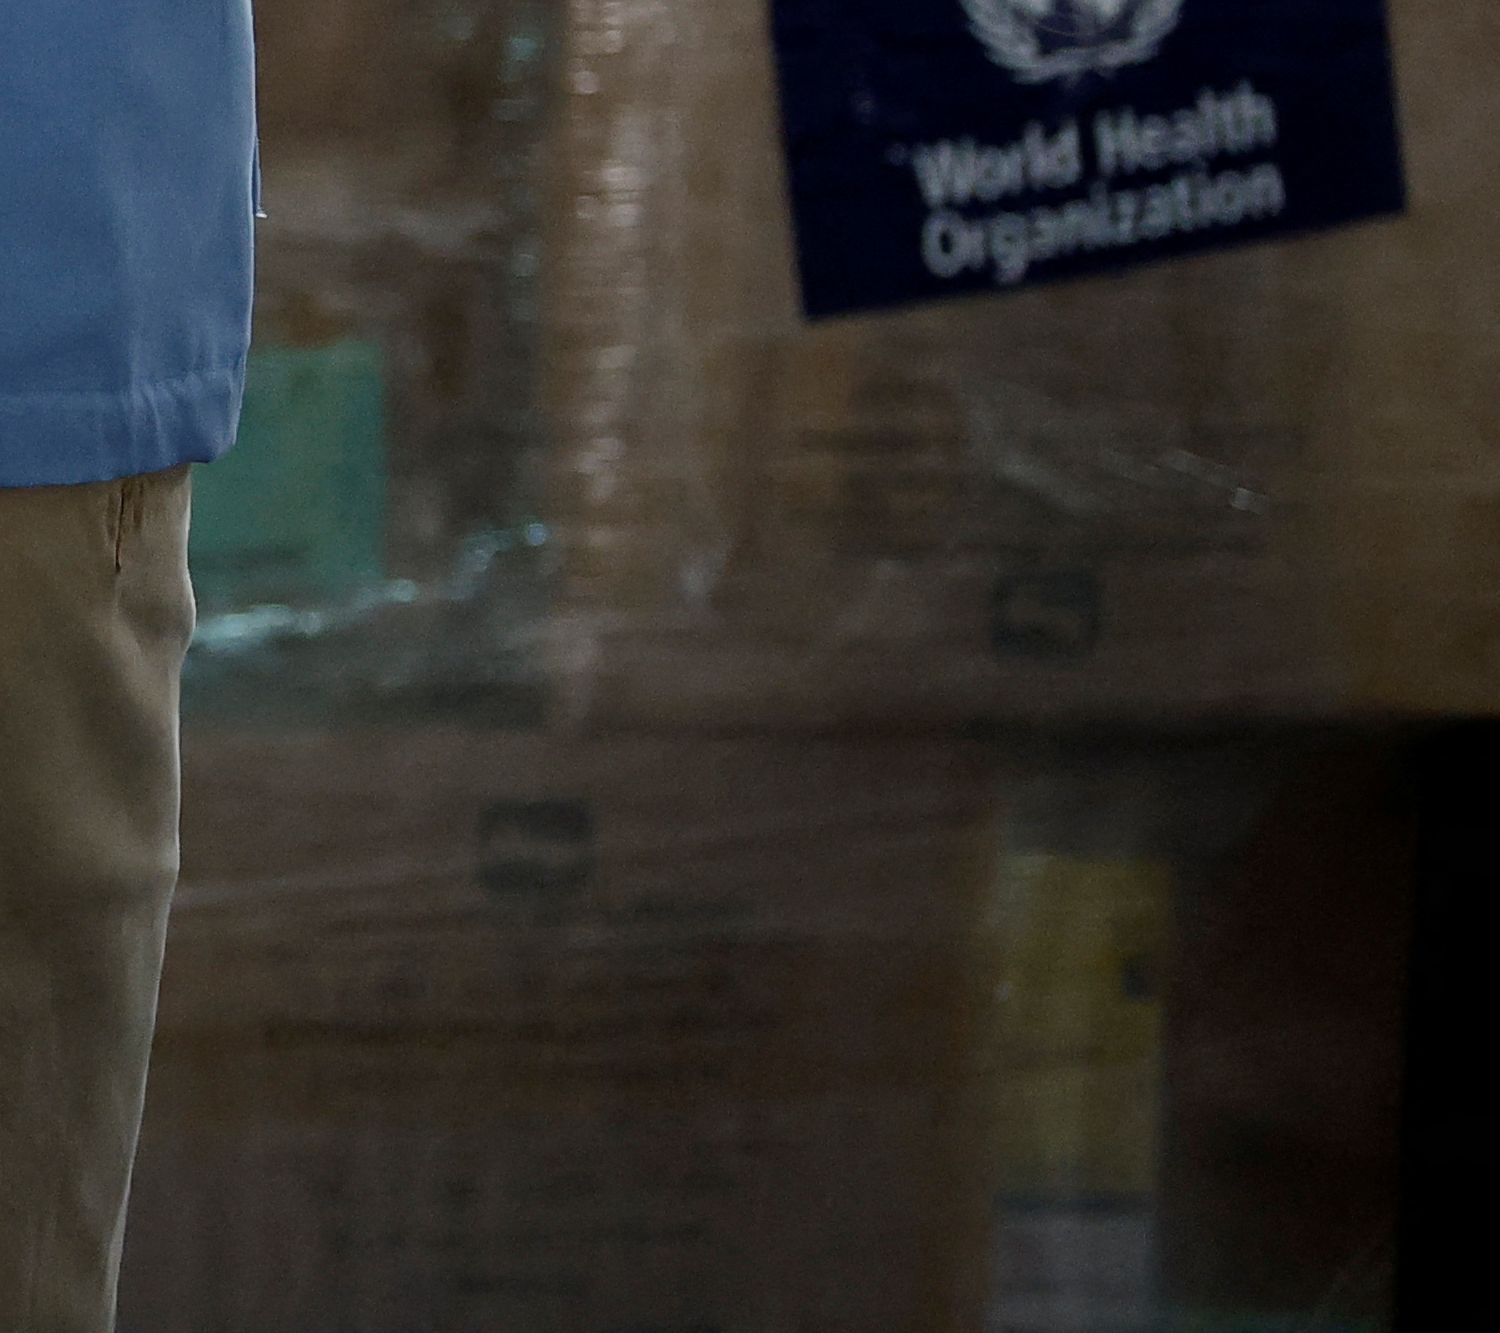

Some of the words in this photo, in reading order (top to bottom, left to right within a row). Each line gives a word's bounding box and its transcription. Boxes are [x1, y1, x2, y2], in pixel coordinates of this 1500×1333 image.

[912, 117, 1083, 206] World
[1097, 79, 1278, 173] Health
[922, 164, 1286, 282] Organization
